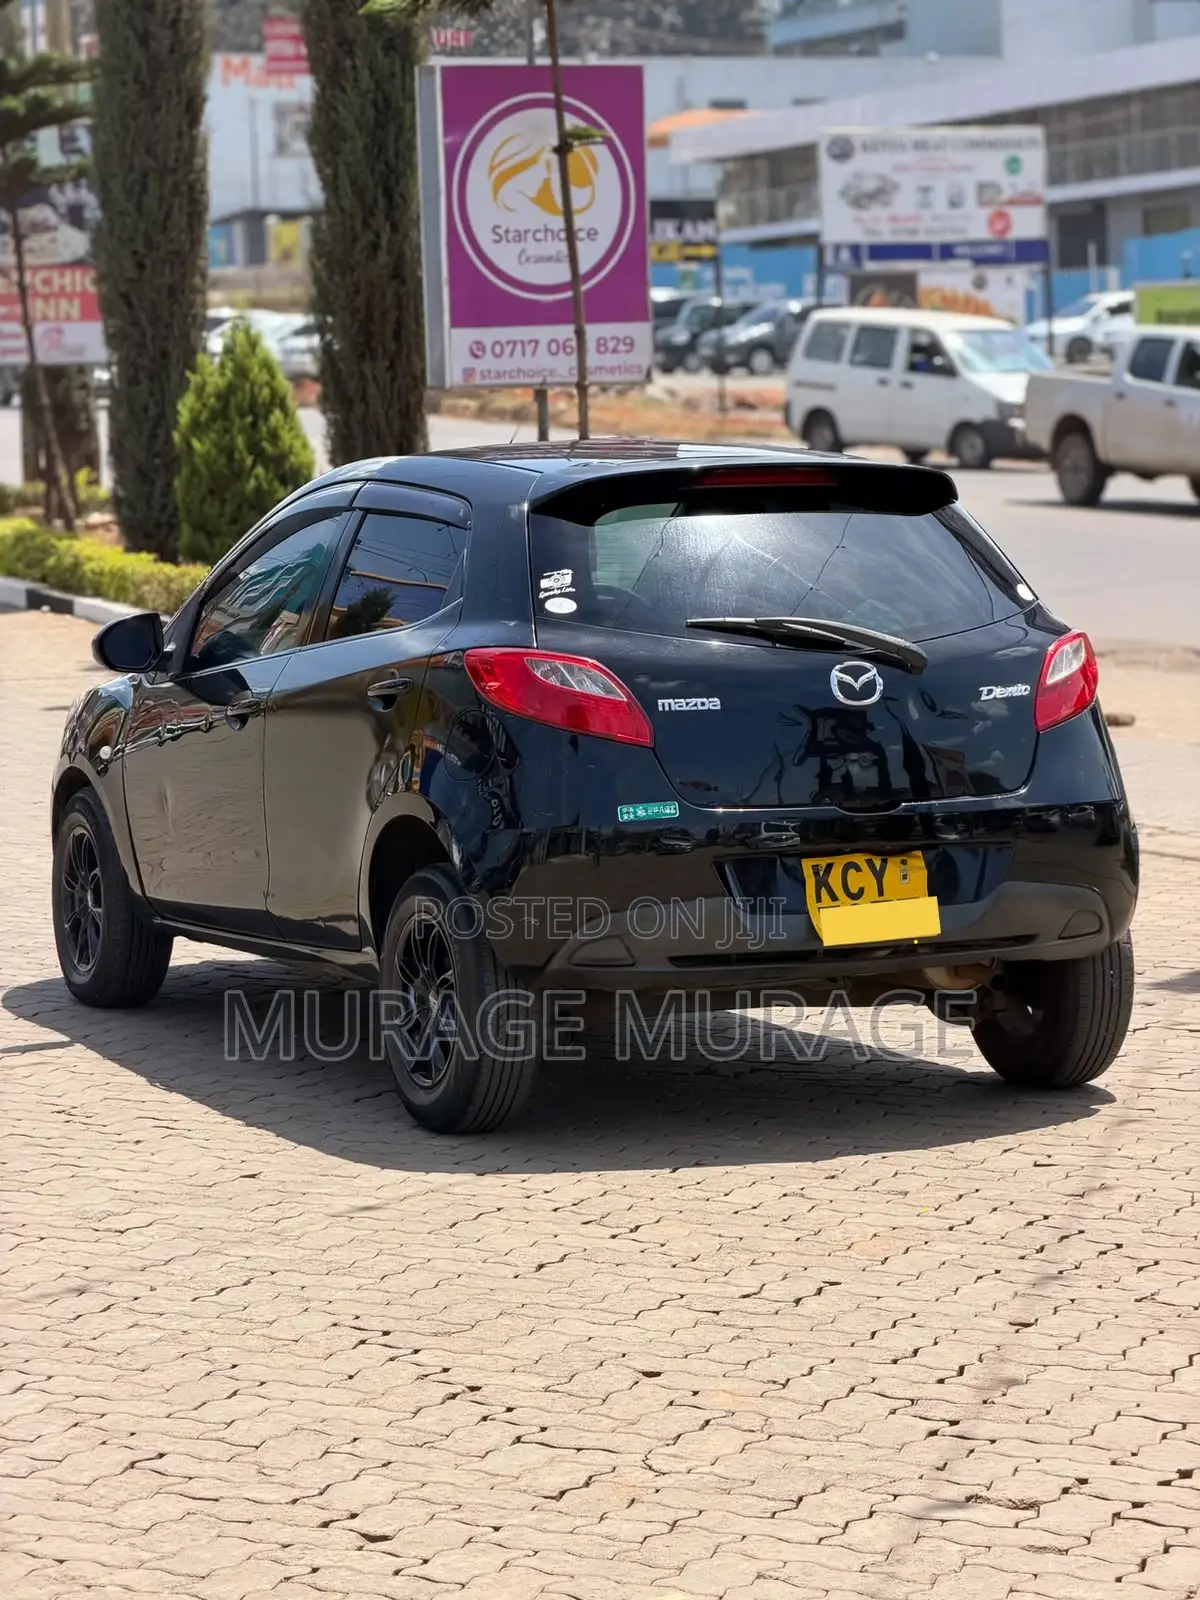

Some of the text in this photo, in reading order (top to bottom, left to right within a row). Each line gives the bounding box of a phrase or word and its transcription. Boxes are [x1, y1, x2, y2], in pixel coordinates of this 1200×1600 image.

[491, 223, 600, 244] Starchoce
[490, 335, 636, 358] 0717 06 829
[978, 683, 1031, 701] Demio
[811, 857, 888, 903] KCY
